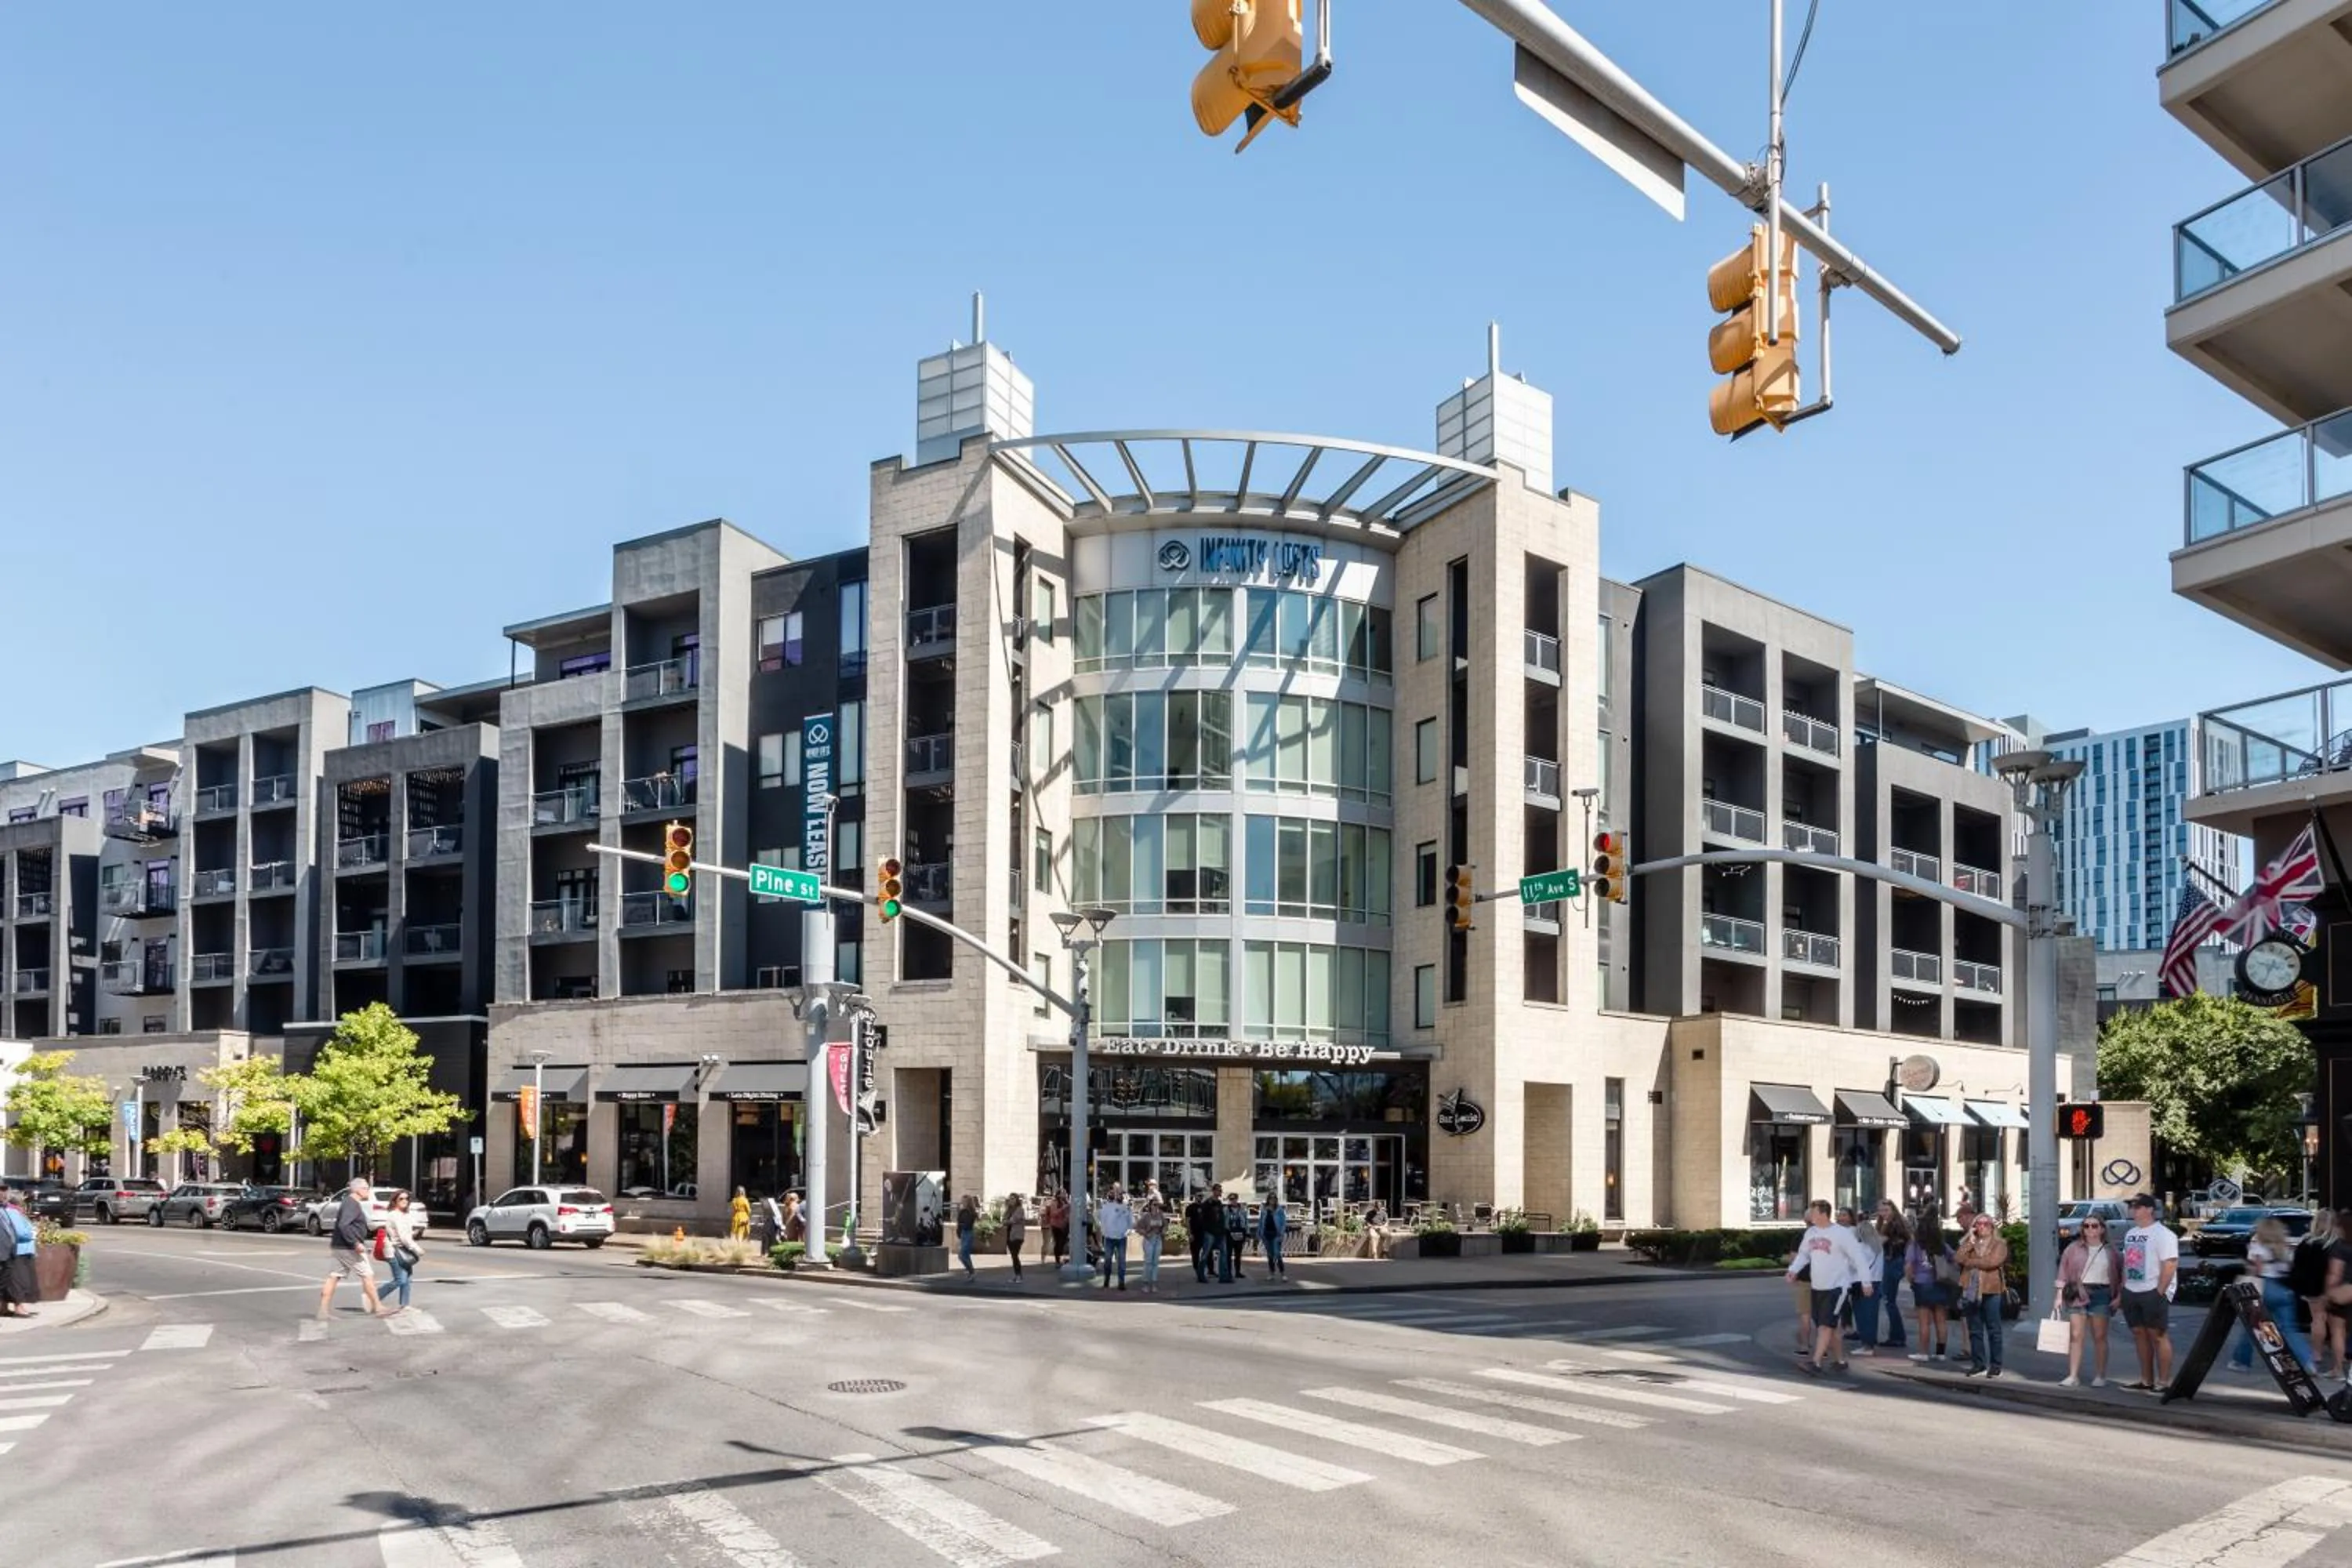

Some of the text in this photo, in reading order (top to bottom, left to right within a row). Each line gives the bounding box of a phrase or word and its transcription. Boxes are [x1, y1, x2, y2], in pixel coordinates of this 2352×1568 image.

[1200, 537, 1268, 572] INFINITY
[806, 760, 829, 813] NOW
[806, 818, 828, 904] LEASI
[756, 869, 815, 898] Pine St
[1523, 876, 1577, 899] 11th Ave S
[865, 1021, 875, 1088] Louie
[1103, 1038, 1376, 1065] Eat Drink Be Happy
[1439, 1114, 1454, 1123] Bar
